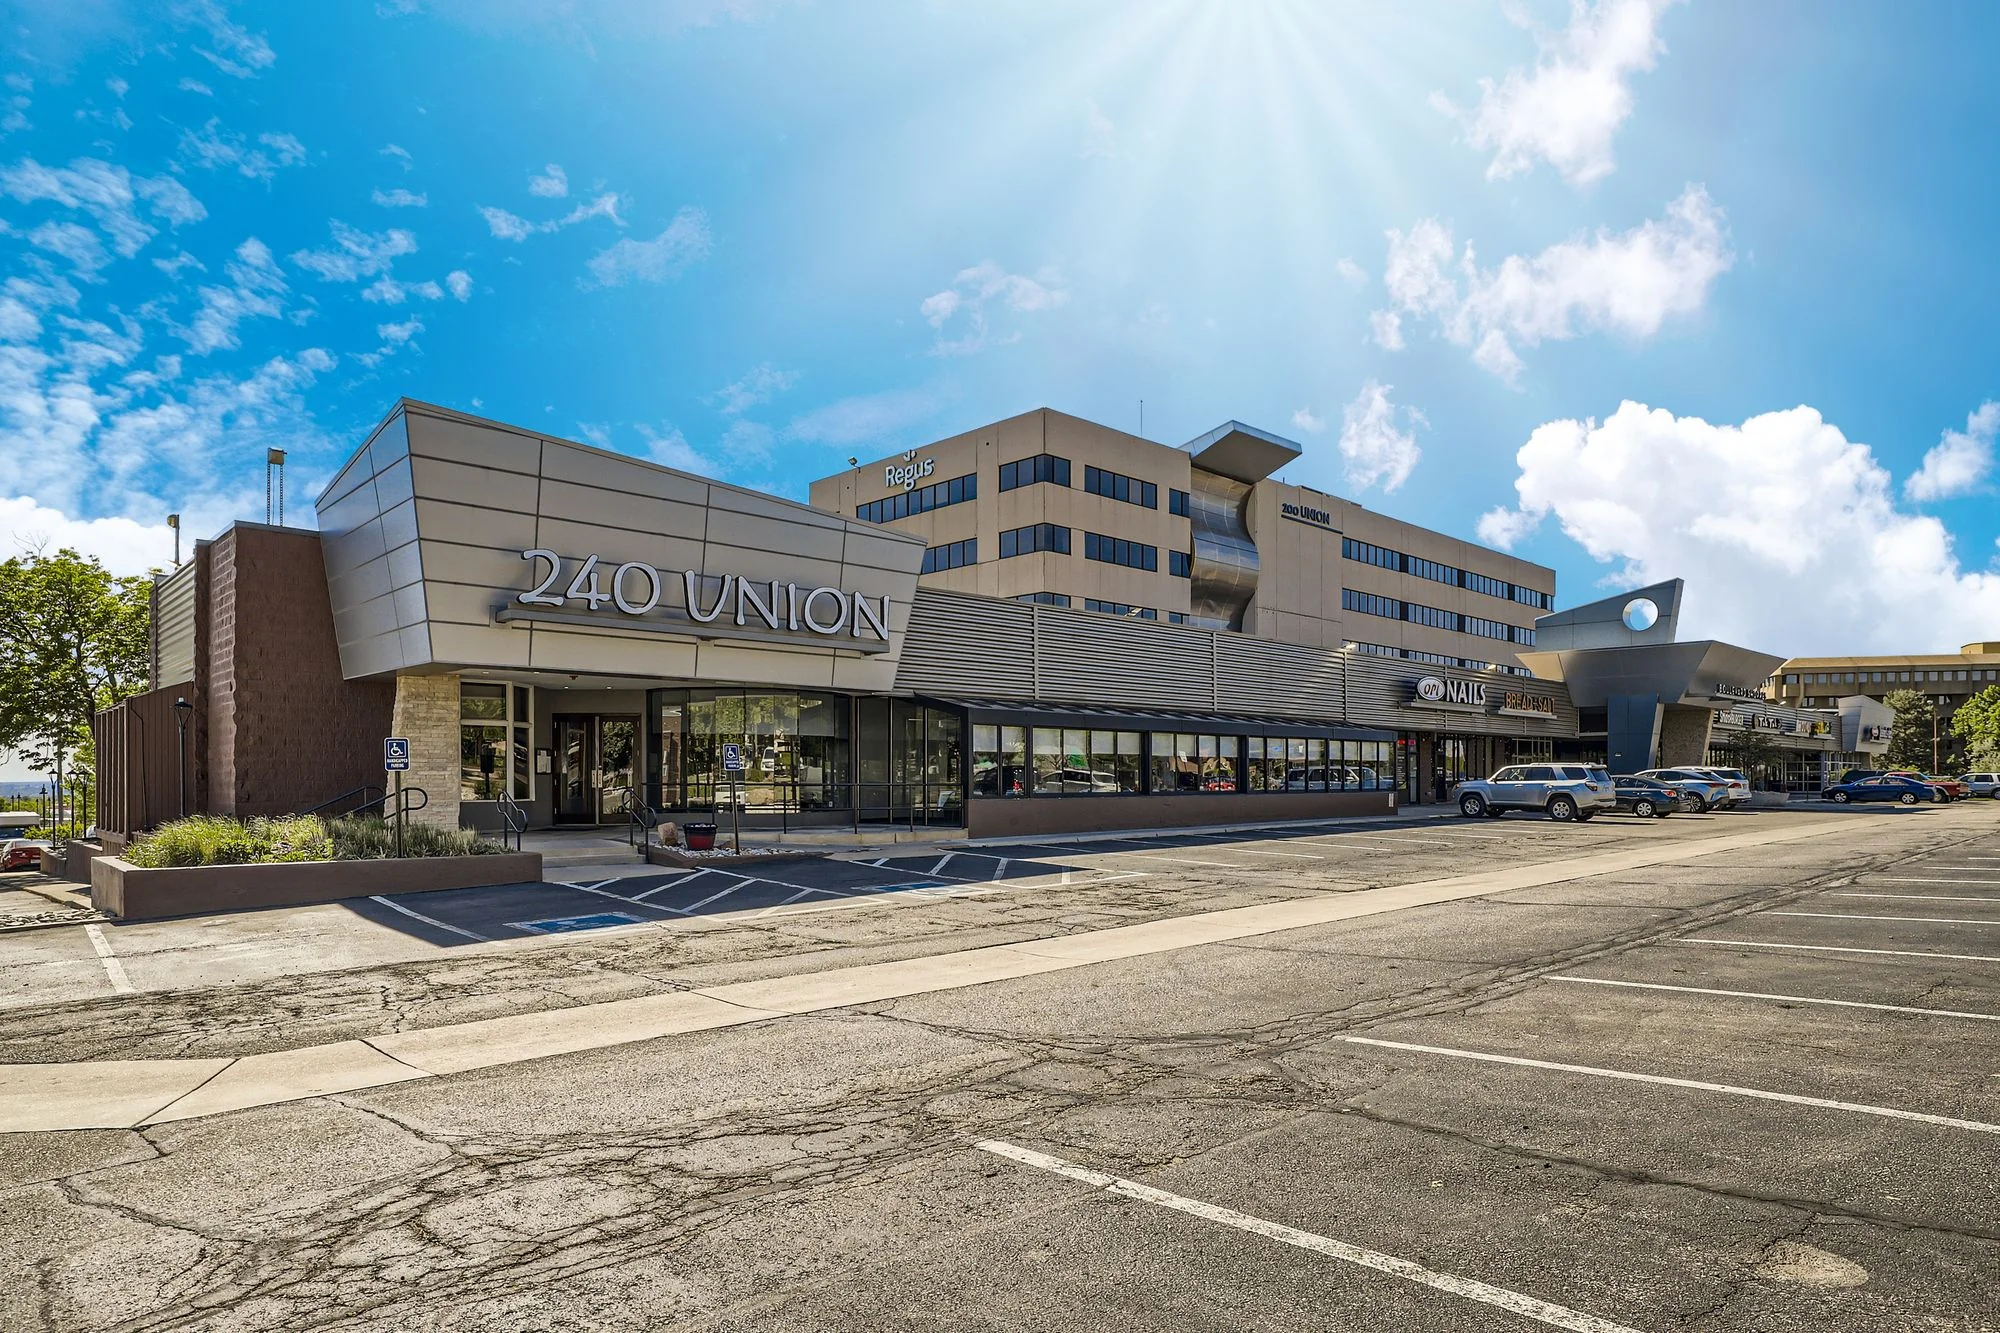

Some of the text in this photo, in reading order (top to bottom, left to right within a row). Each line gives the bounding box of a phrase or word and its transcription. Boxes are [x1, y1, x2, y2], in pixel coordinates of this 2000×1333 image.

[885, 459, 935, 491] Regus
[1281, 502, 1330, 526] 200 UNION
[517, 549, 890, 640] 240 UNION
[1446, 679, 1487, 706] NAILS
